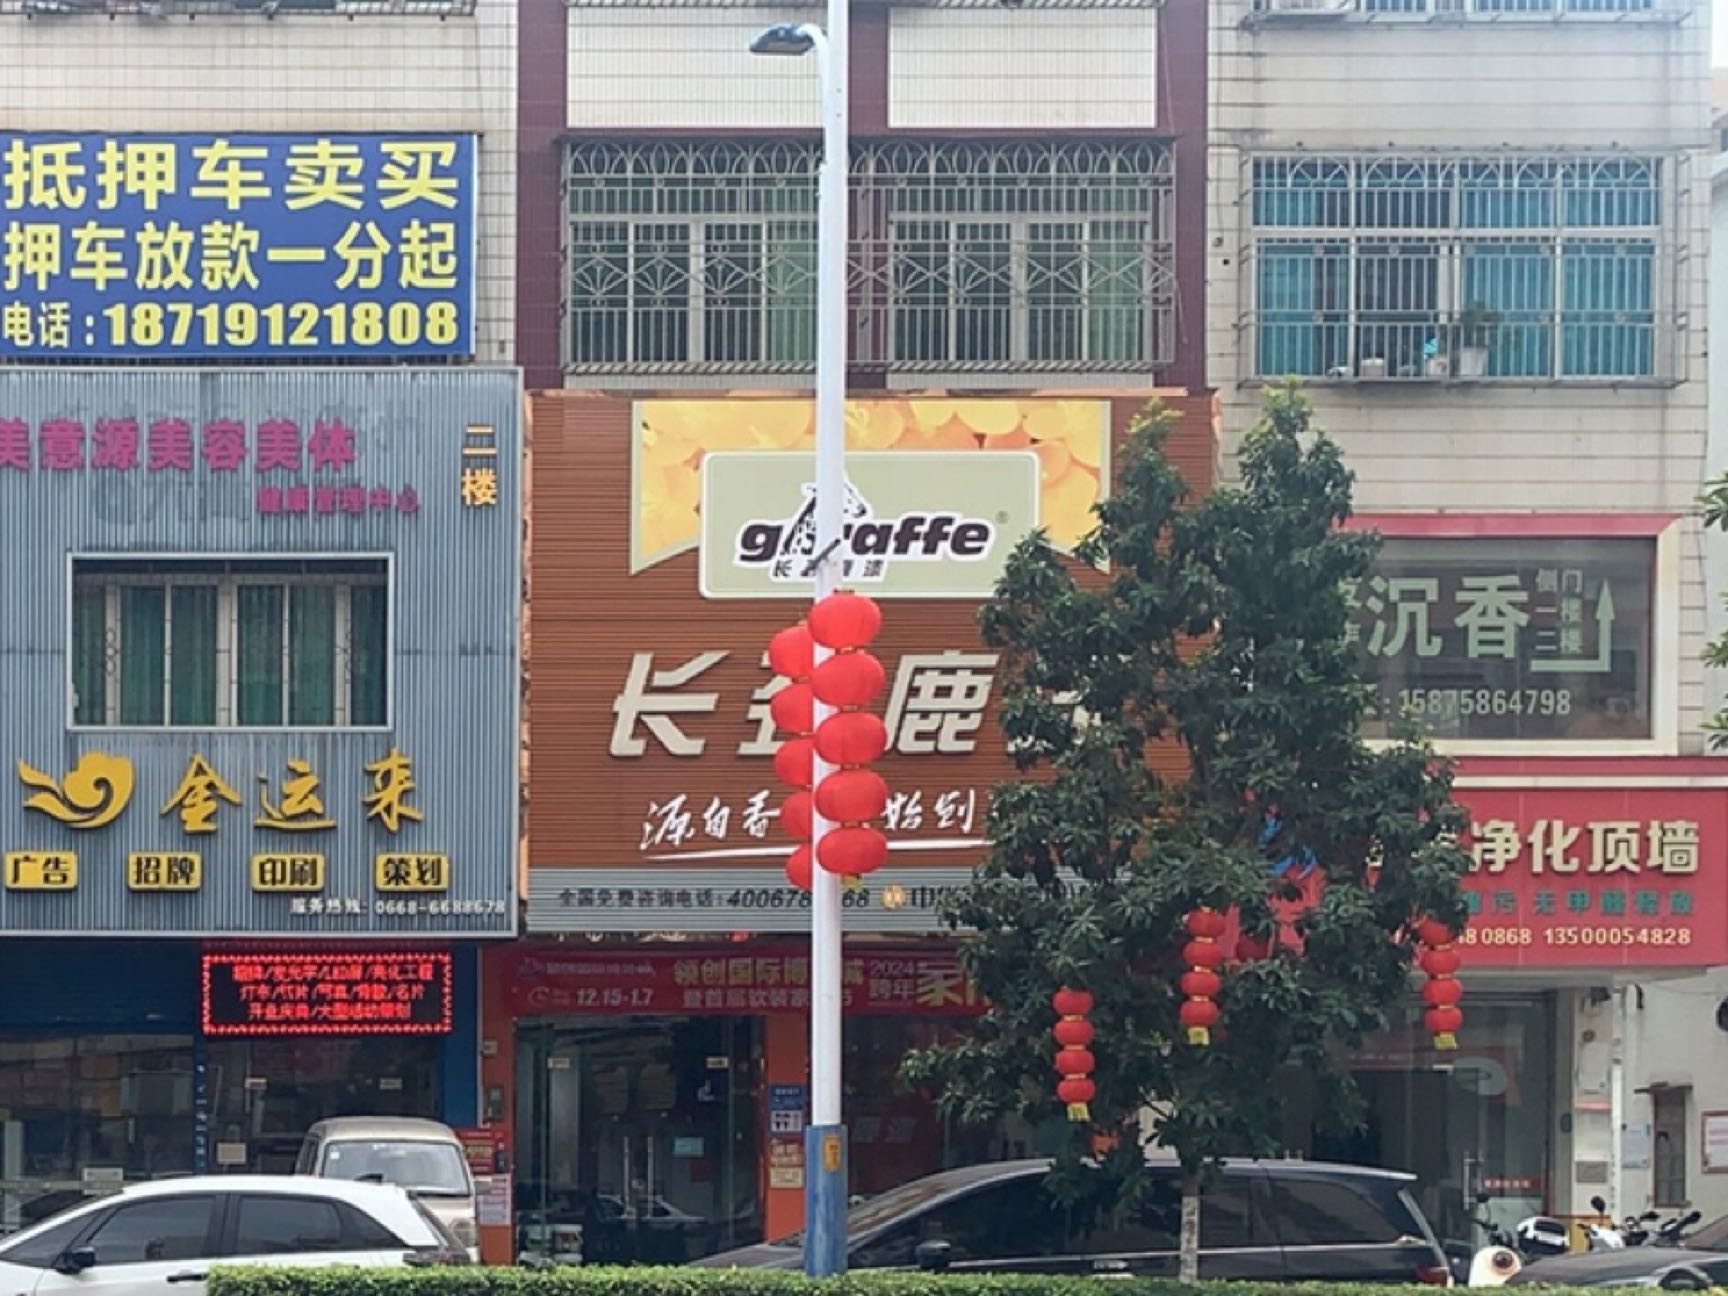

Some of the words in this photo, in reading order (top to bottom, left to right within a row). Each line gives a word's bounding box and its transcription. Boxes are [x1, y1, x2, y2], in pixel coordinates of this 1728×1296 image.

[2, 138, 459, 211] 抵押车卖买
[2, 220, 458, 291] 押车放款一分起
[461, 424, 499, 506] 二楼
[639, 789, 780, 852] 源自香
[11, 855, 71, 886] 广告
[133, 855, 196, 886] 招牌
[257, 856, 319, 887] 印刷
[382, 856, 443, 887] 策划
[1545, 927, 1692, 946] 13500054828
